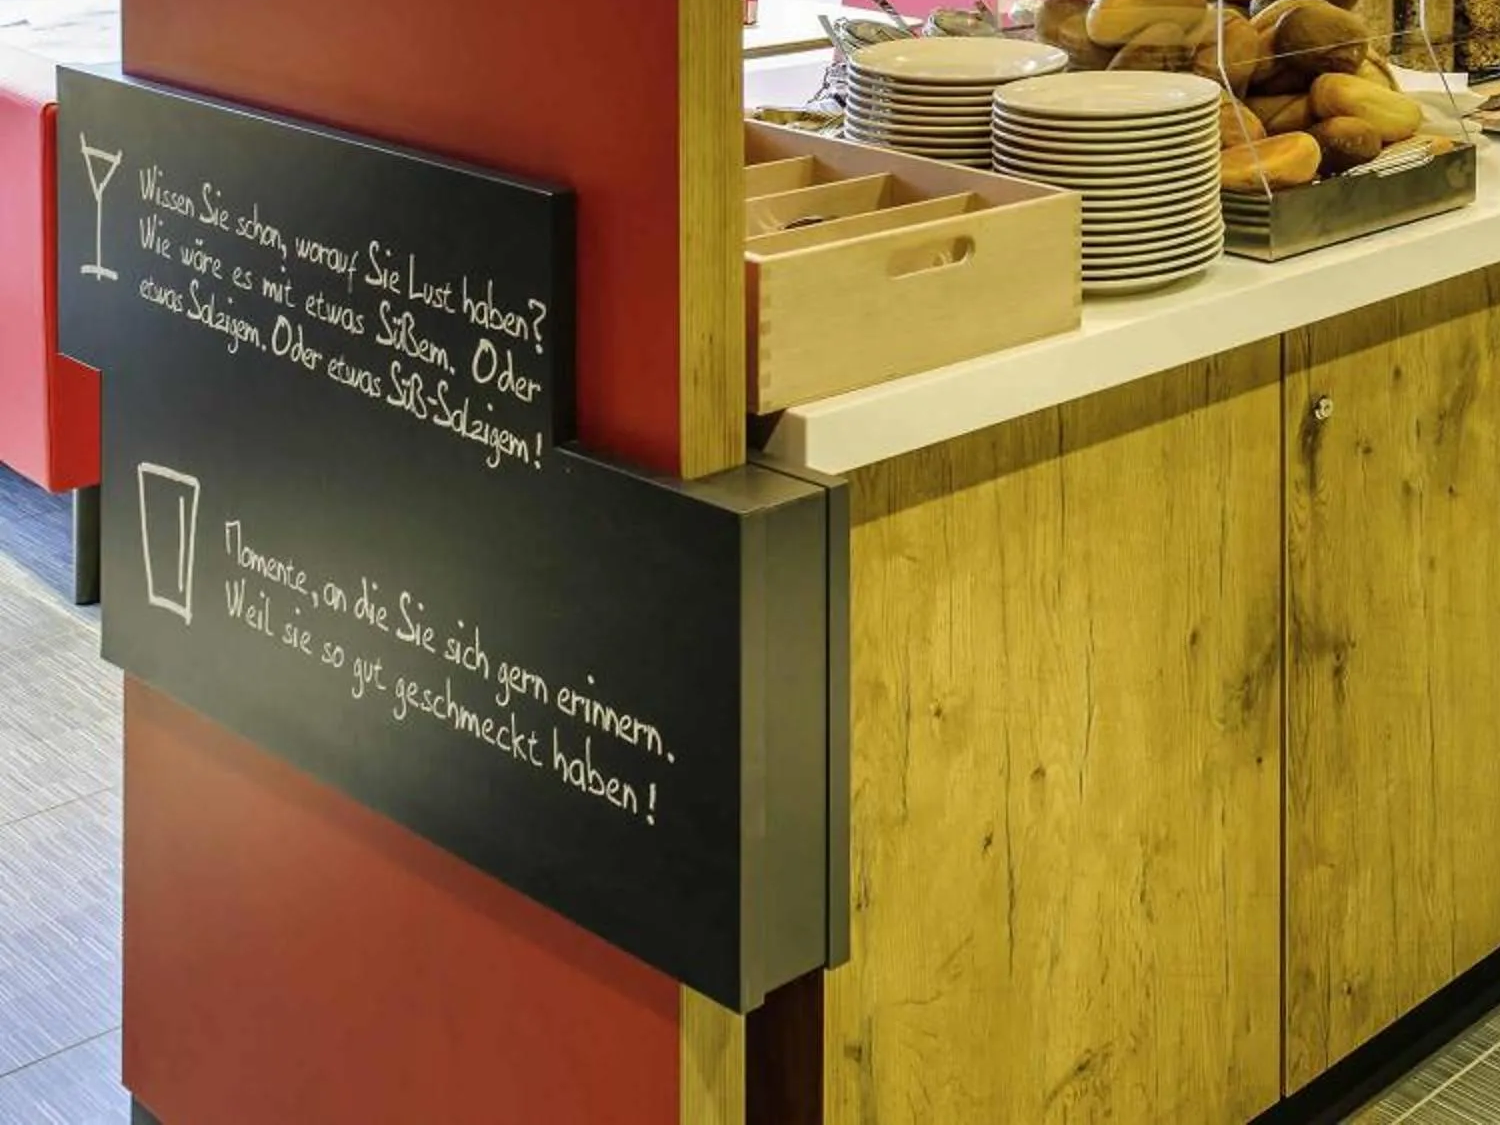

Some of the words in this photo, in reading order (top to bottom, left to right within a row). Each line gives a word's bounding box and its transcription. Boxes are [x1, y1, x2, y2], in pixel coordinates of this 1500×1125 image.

[140, 165, 194, 217] Wissen
[199, 182, 230, 231] Sie
[236, 203, 287, 260] schon,
[295, 237, 359, 293] worauf
[364, 240, 401, 294] Sie
[408, 253, 456, 314] Lust
[462, 275, 547, 355] haben?
[140, 214, 171, 259] Wie
[180, 238, 223, 279] wäre
[232, 267, 252, 290] es
[262, 265, 295, 307] mit
[305, 291, 364, 335] etwas
[376, 299, 455, 375] Süßem.
[472, 338, 543, 402] Oder
[139, 276, 184, 313] etwas
[186, 278, 267, 354] Salzigem.
[271, 315, 323, 370] Oder
[327, 355, 381, 397] etwas
[386, 360, 542, 469] Süß-Salzigem!
[225, 520, 318, 608] Momente,
[323, 582, 347, 612] an
[354, 577, 389, 631] die
[396, 590, 436, 653] Sie
[444, 620, 489, 679] sich
[495, 662, 548, 707] gern
[557, 675, 675, 764] erinnern.
[225, 578, 273, 636] Weil
[282, 607, 312, 655] sie
[321, 642, 344, 667] so
[352, 657, 386, 699] gut
[393, 677, 543, 768] geschmeckt
[553, 727, 656, 826] haben!
